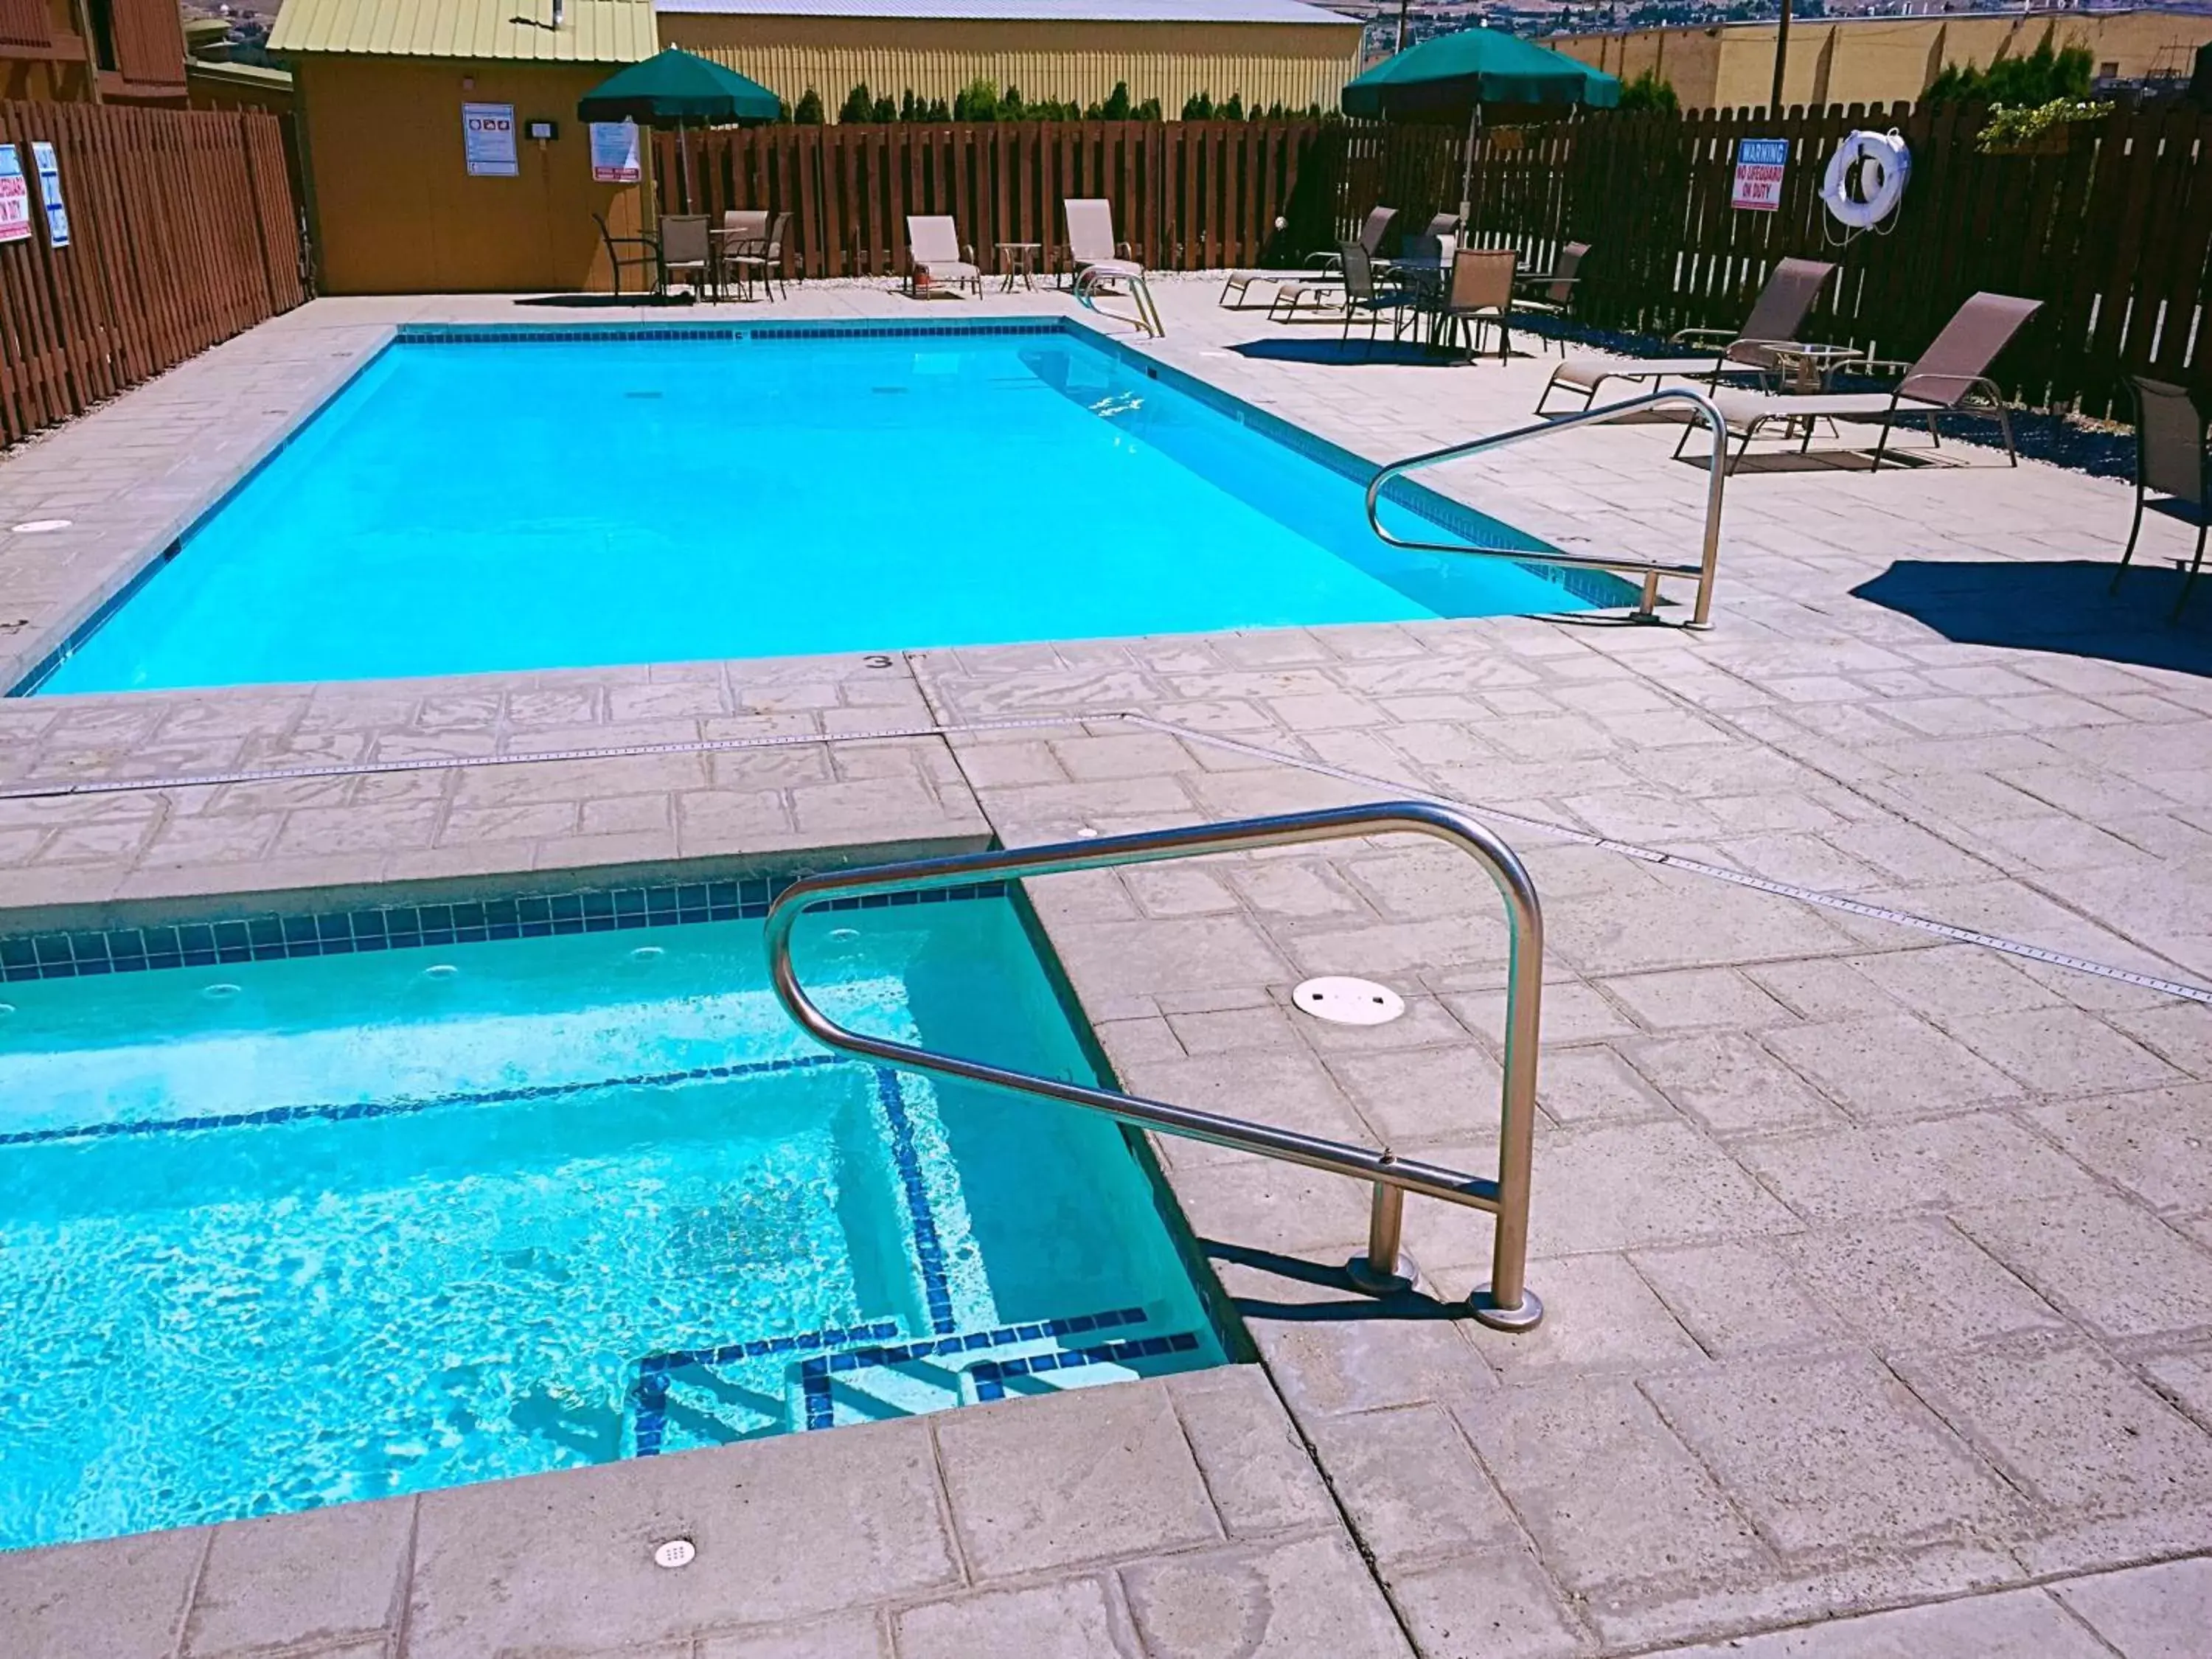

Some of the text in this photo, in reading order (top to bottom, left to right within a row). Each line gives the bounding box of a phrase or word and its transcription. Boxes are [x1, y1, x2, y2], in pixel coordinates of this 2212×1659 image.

[1742, 143, 1784, 163] WARNING
[1737, 164, 1782, 182] NO LIFEGUARD
[1742, 182, 1772, 199] ON DUTY
[863, 655, 893, 669] 3
